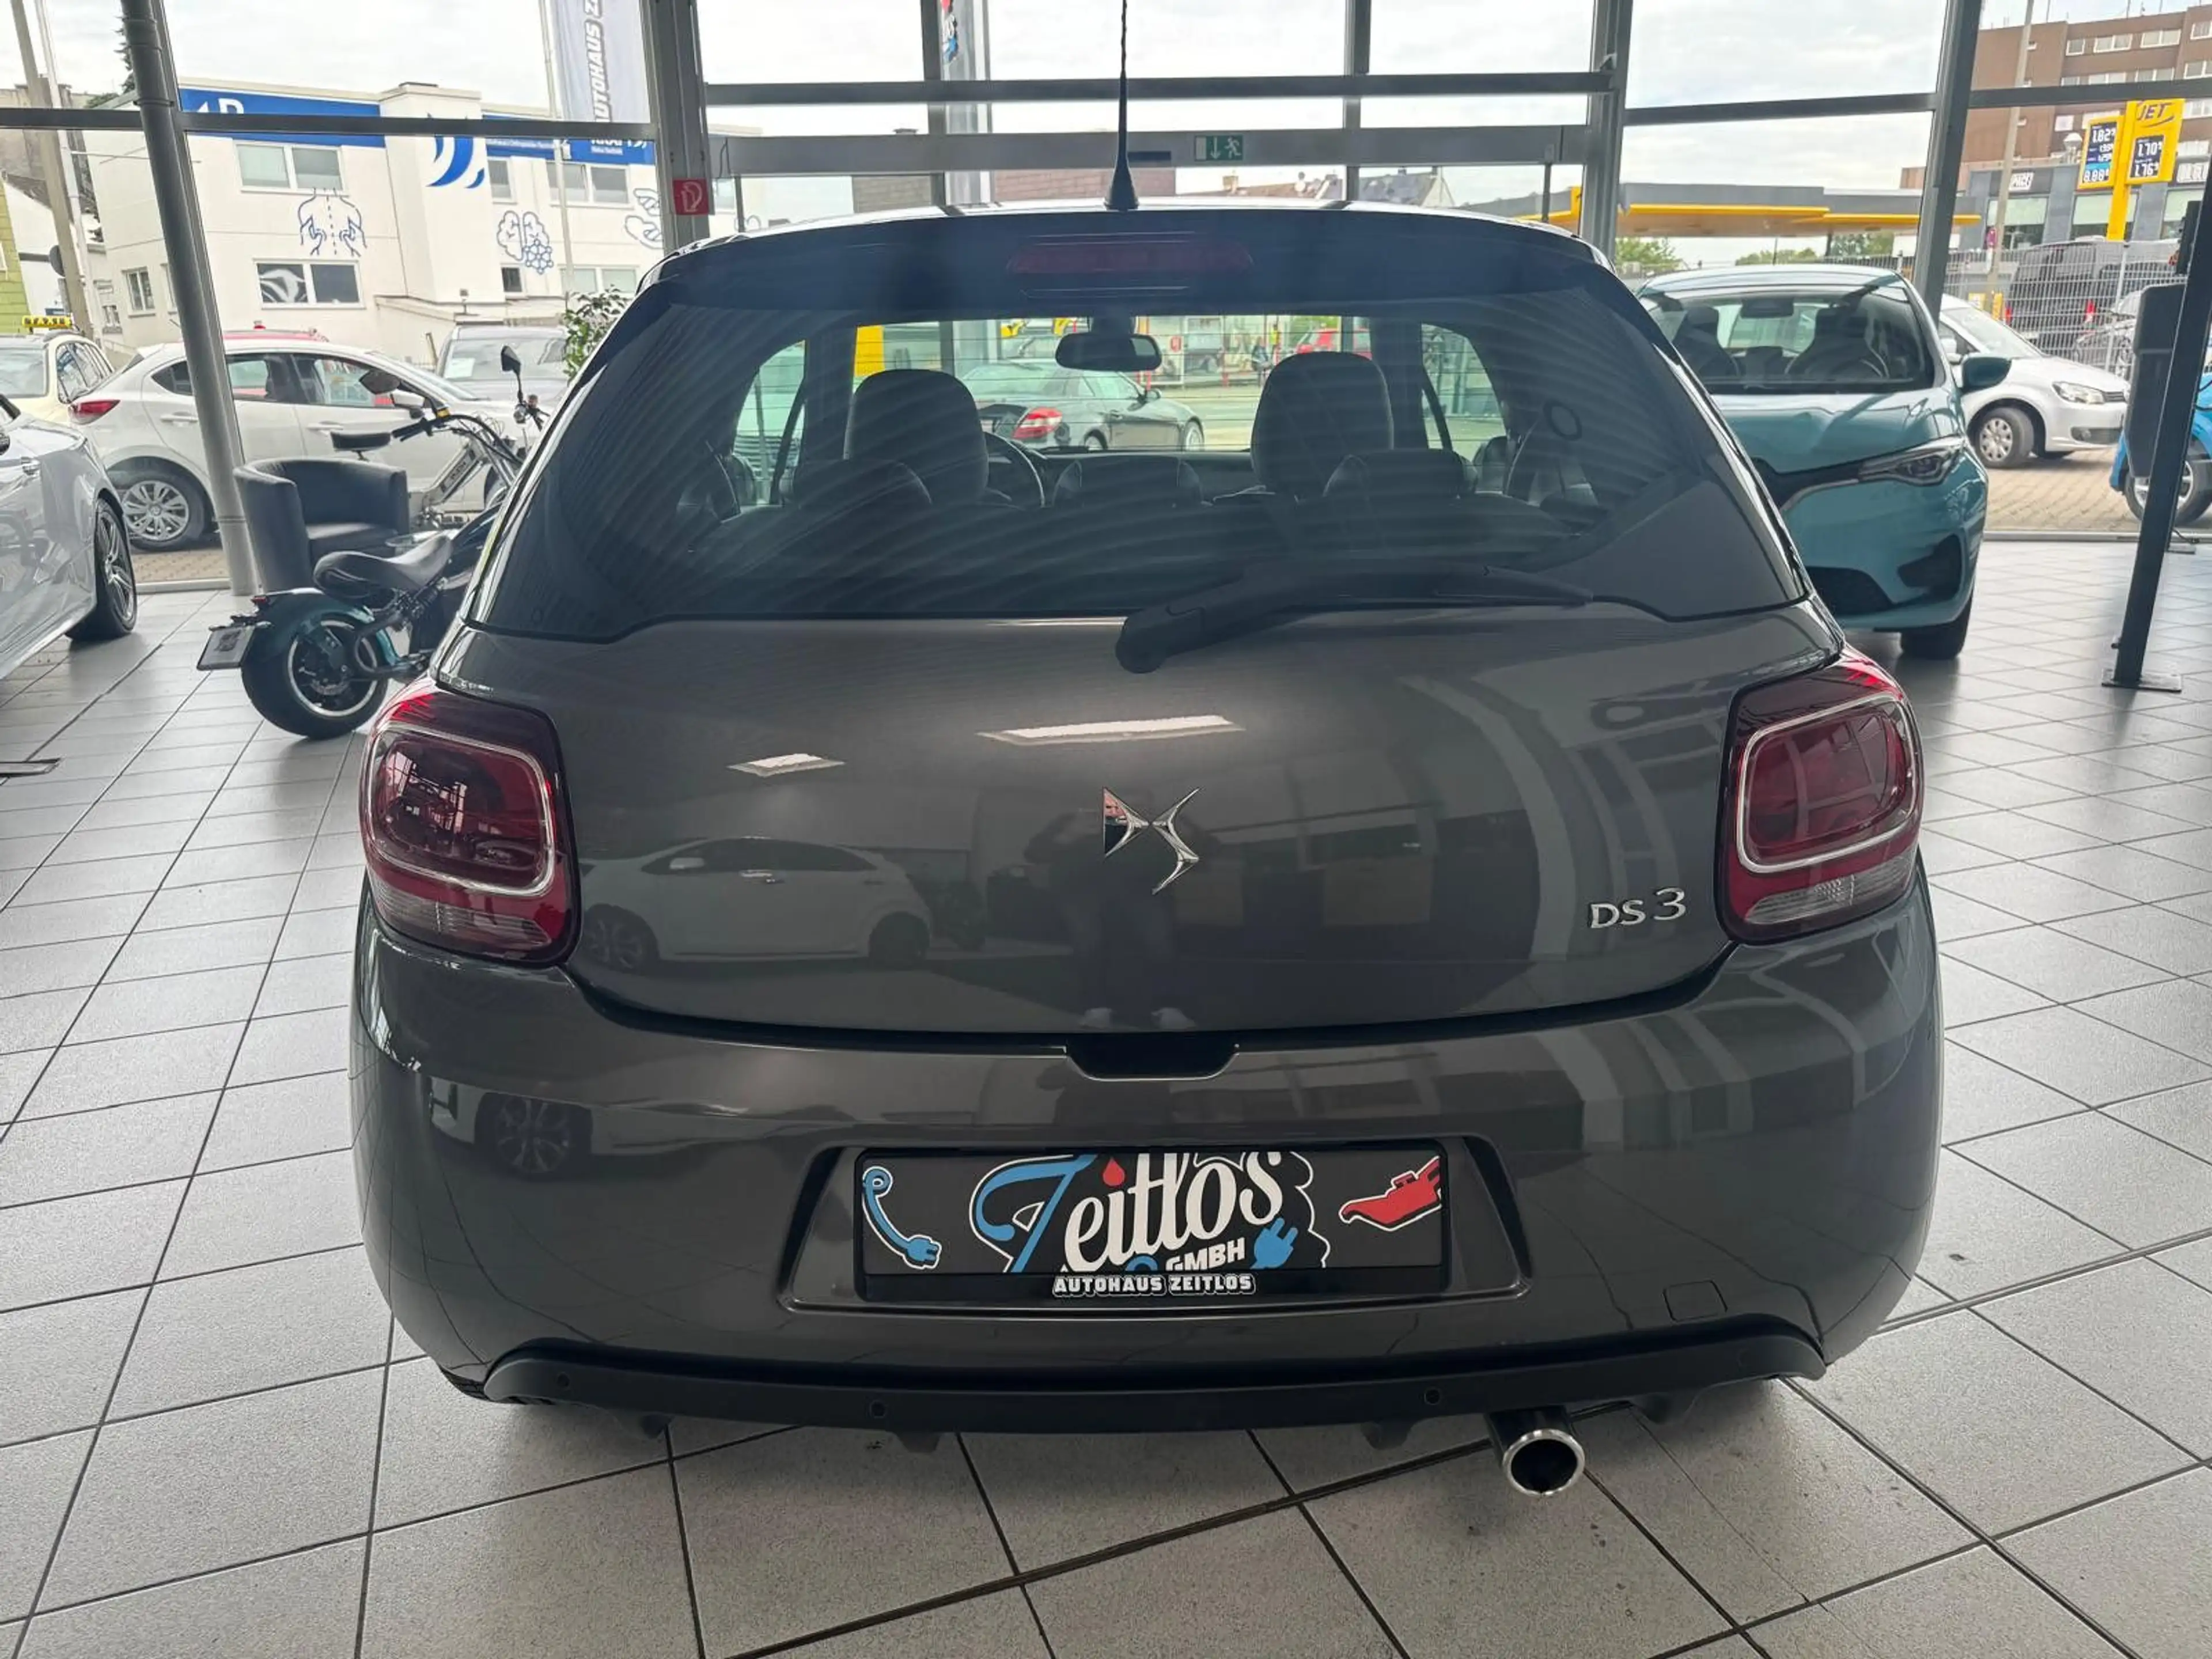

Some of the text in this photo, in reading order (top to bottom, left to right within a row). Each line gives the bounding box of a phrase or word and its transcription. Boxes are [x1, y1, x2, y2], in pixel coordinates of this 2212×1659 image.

[585, 20, 611, 122] UTOHAUS
[2136, 102, 2173, 121] JET
[1590, 887, 1686, 928] DS 3
[1165, 1237, 1246, 1271] GMBH
[1054, 1274, 1254, 1294] AUTOHAUS ZEITLOS
